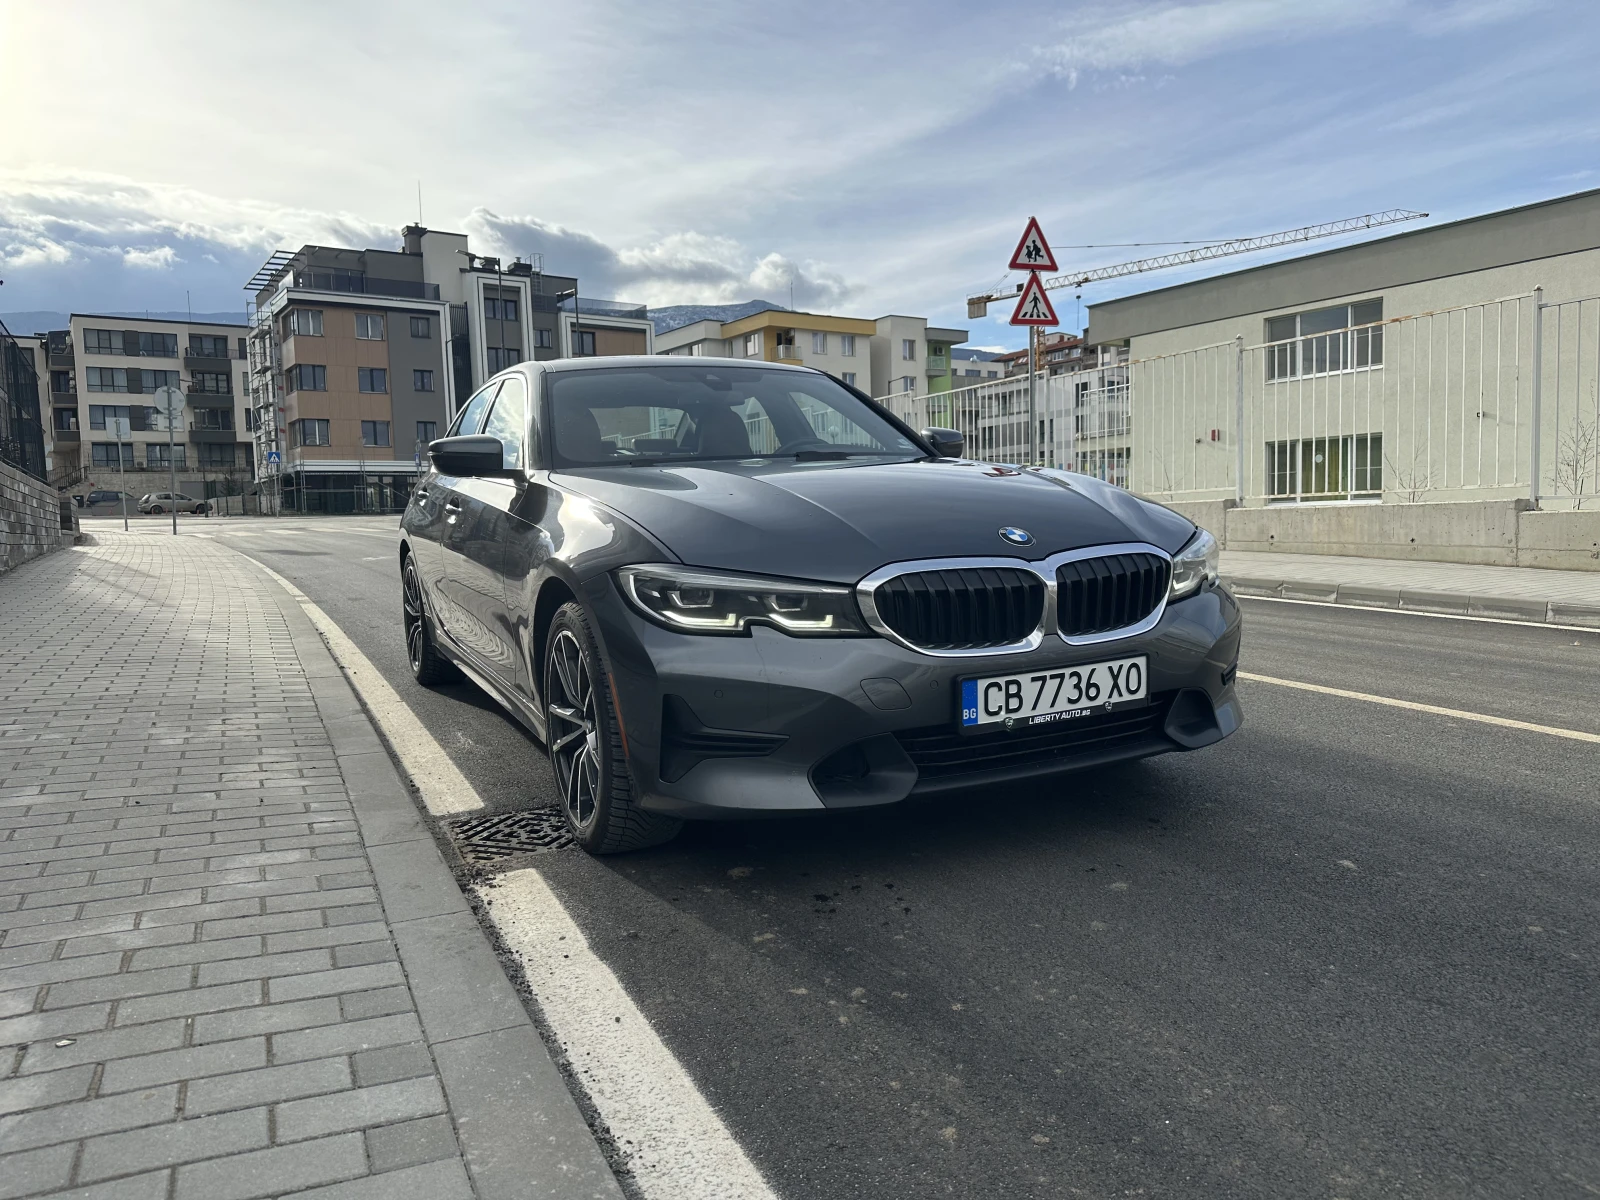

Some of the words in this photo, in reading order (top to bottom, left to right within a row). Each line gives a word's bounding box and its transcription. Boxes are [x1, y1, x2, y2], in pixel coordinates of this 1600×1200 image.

[984, 679, 1023, 716] CB
[1031, 668, 1100, 711] 7736
[1107, 662, 1141, 699] XO
[963, 708, 977, 719] BG
[1029, 713, 1060, 724] LIBERTY
